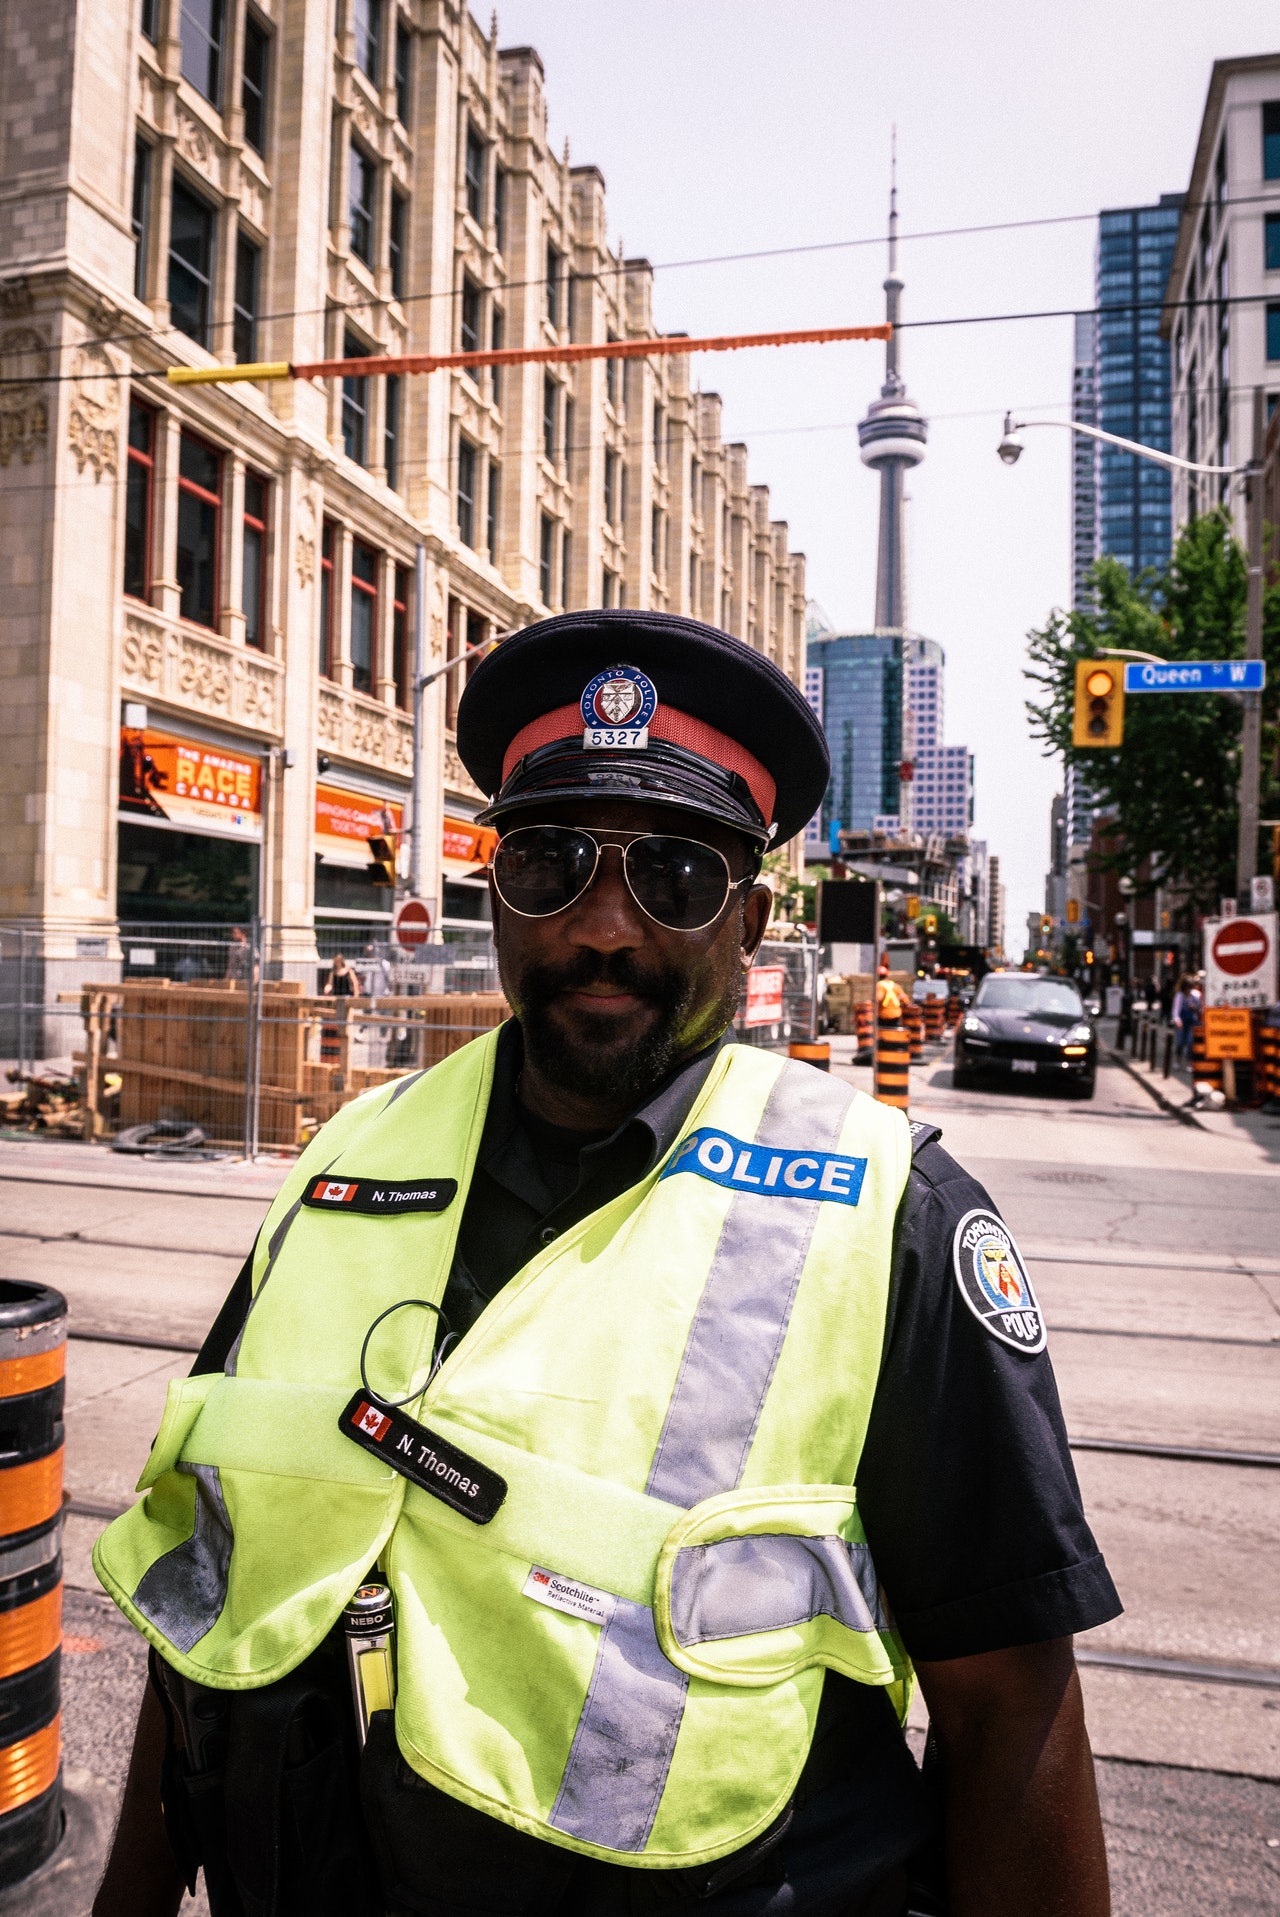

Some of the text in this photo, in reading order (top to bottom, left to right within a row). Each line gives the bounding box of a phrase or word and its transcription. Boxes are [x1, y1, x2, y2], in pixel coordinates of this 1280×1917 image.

[1142, 665, 1202, 685] Queen
[1229, 664, 1247, 682] W
[584, 670, 652, 718] TORONTO POLICE
[592, 731, 641, 745] 5327
[177, 746, 200, 763] THE
[176, 758, 252, 798] RACE
[175, 782, 251, 808] CANADA
[669, 1137, 856, 1195] POLICE
[372, 1190, 437, 1202] N. Thomas
[962, 1219, 1011, 1251] TORONTO
[1001, 1311, 1040, 1341] POLICE
[396, 1434, 480, 1498] N. Thomas
[533, 1571, 551, 1586] 3M
[547, 1590, 605, 1618] Reflective Material
[351, 1615, 384, 1626] NEBO
